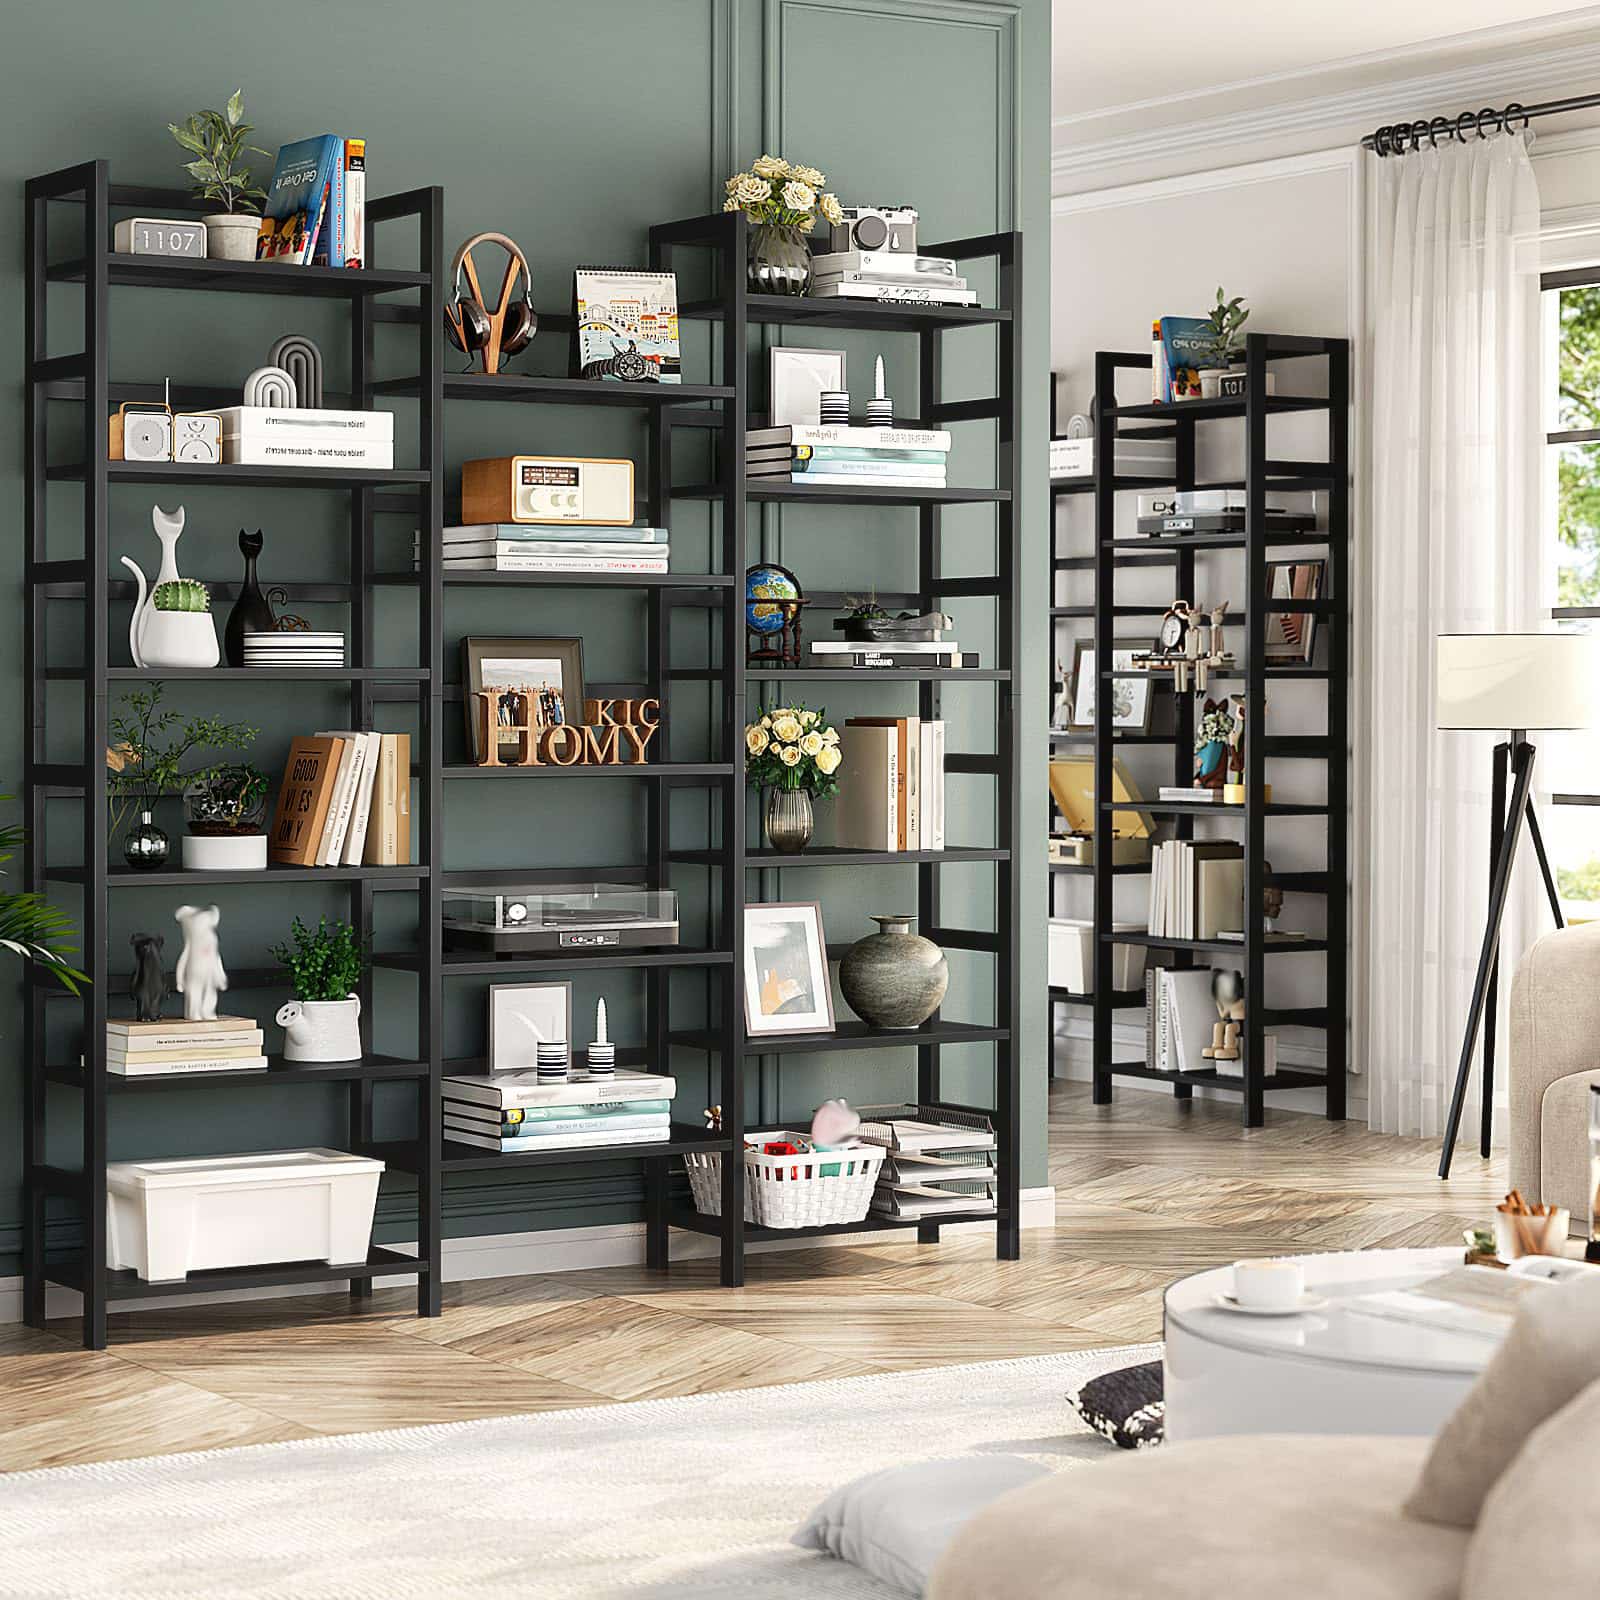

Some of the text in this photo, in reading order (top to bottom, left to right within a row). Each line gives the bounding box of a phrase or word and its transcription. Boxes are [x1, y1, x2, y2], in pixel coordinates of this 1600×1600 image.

[275, 169, 316, 190] Get Over It
[594, 698, 660, 727] KIC
[478, 692, 659, 767] HOMY
[292, 758, 319, 782] GOOD
